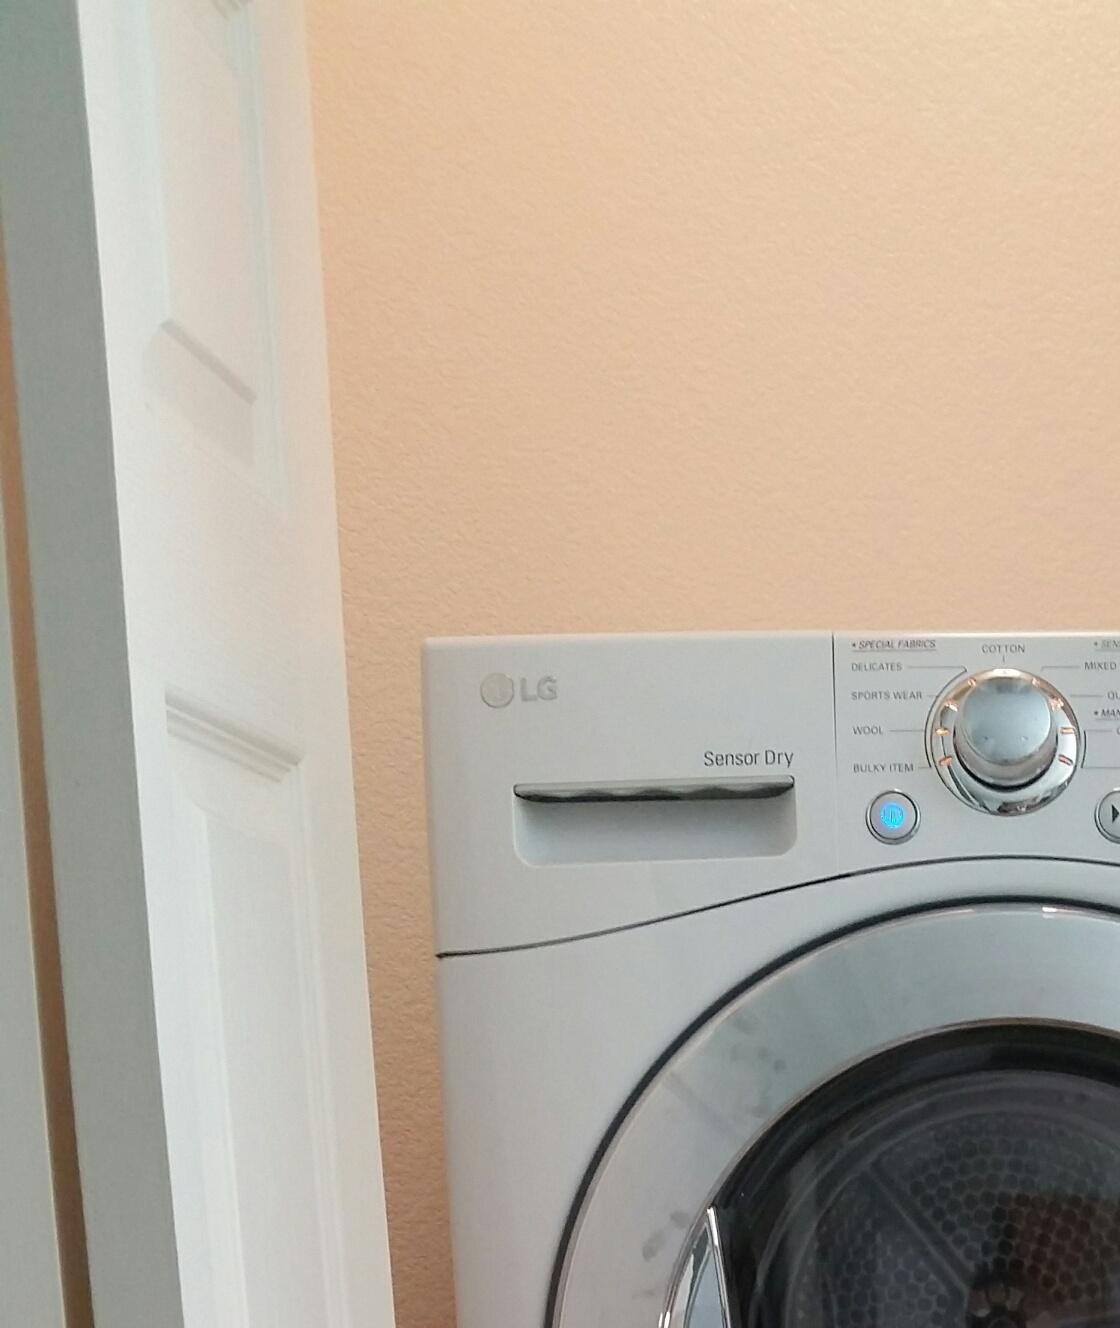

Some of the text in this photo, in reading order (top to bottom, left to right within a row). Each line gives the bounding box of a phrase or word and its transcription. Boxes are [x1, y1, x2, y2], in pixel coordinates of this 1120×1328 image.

[859, 640, 936, 649] SPECIAL FABRICS
[982, 644, 1025, 653] COTTON
[851, 663, 902, 671] DELICATES
[1084, 662, 1116, 670] MIXED
[520, 676, 557, 701] LG
[851, 691, 922, 700] SPORTS WEAR
[853, 726, 883, 735] WOOL
[704, 750, 794, 768] Sensor Dry
[853, 764, 914, 773] BULKY ITEM
